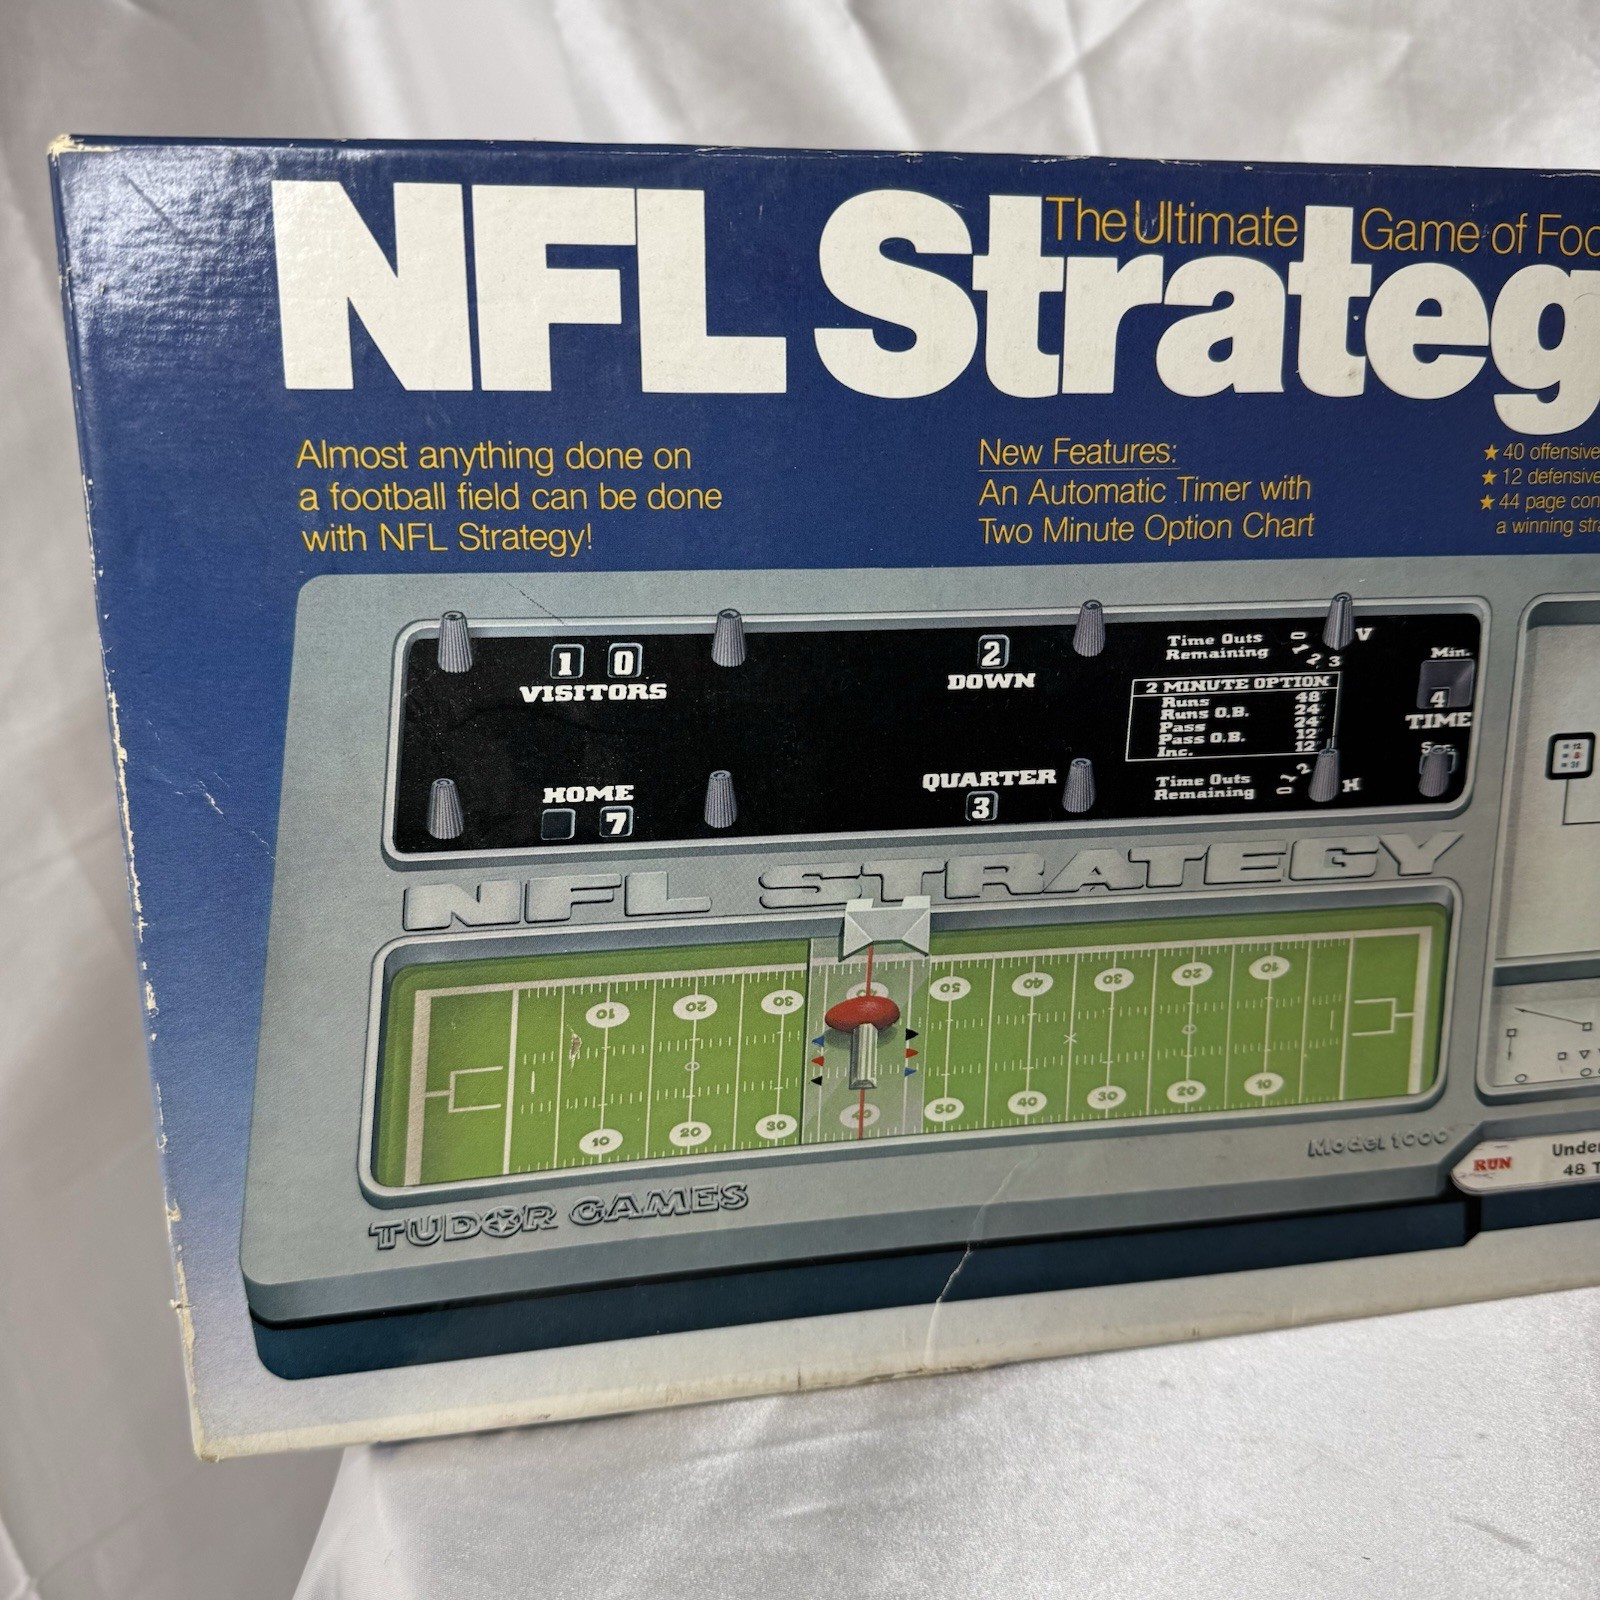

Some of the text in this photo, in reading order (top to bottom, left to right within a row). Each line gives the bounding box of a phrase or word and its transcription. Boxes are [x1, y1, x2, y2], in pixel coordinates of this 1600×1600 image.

[1046, 196, 1127, 245] The
[1134, 201, 1298, 247] Ultimate
[1360, 207, 1480, 254] Game
[1491, 212, 1528, 255] of
[271, 180, 1600, 435] NFL Strateg
[297, 439, 692, 477] Almost anything done on
[979, 437, 1178, 466] New Features:
[1502, 442, 1600, 460] 40 offensive
[1502, 467, 1600, 485] 12 defensive
[299, 481, 722, 511] a football field can be done
[978, 474, 1312, 506] An Automatic Timer with
[1499, 492, 1520, 509] 44
[1524, 495, 1566, 513] page
[978, 513, 1315, 548] Two Minute Option Chart
[1496, 521, 1506, 534] a
[1512, 517, 1574, 538] winning
[302, 522, 593, 558] with NFL Strategy!
[1167, 633, 1263, 647] Time Outs
[1355, 627, 1374, 642] V
[981, 641, 1001, 667] 2
[1166, 646, 1270, 661] Remaining
[1306, 653, 1322, 665] 2
[1328, 655, 1342, 668] 3
[1430, 647, 1472, 659] Min.
[558, 651, 634, 676] 1 0
[947, 673, 1036, 690] DOWN
[1146, 675, 1330, 694] 2 MINUTE OPTION
[519, 683, 668, 703] VISITORS
[1430, 690, 1446, 708] 4
[1162, 696, 1210, 708] Runs
[1160, 709, 1209, 721] Runs
[1214, 706, 1250, 719] O.B.
[1405, 711, 1472, 730] TIME
[1159, 721, 1206, 733] Pass
[1158, 734, 1205, 746] Pass
[1210, 732, 1246, 744] O.B.
[1157, 747, 1194, 758] Inc.
[922, 769, 1057, 792] QUARTER
[1156, 773, 1251, 788] Time Outs
[1341, 777, 1362, 793] H
[542, 785, 634, 804] HOME
[1154, 788, 1256, 800] Remaining
[971, 797, 990, 819] 3
[605, 812, 627, 834] 7
[402, 829, 1465, 931] NFL STRATEGY
[1176, 1085, 1197, 1097] 20
[1255, 1078, 1273, 1090] 10
[1017, 1096, 1038, 1108] 40
[1097, 1090, 1118, 1102] 30
[934, 1103, 956, 1115] 50
[680, 1126, 702, 1139] 20
[766, 1120, 787, 1132] 30
[592, 1136, 610, 1147] 10
[1552, 1140, 1600, 1157] Unde
[1473, 1156, 1512, 1172] RUN
[1563, 1163, 1586, 1176] 48
[568, 1181, 749, 1225] GAMES
